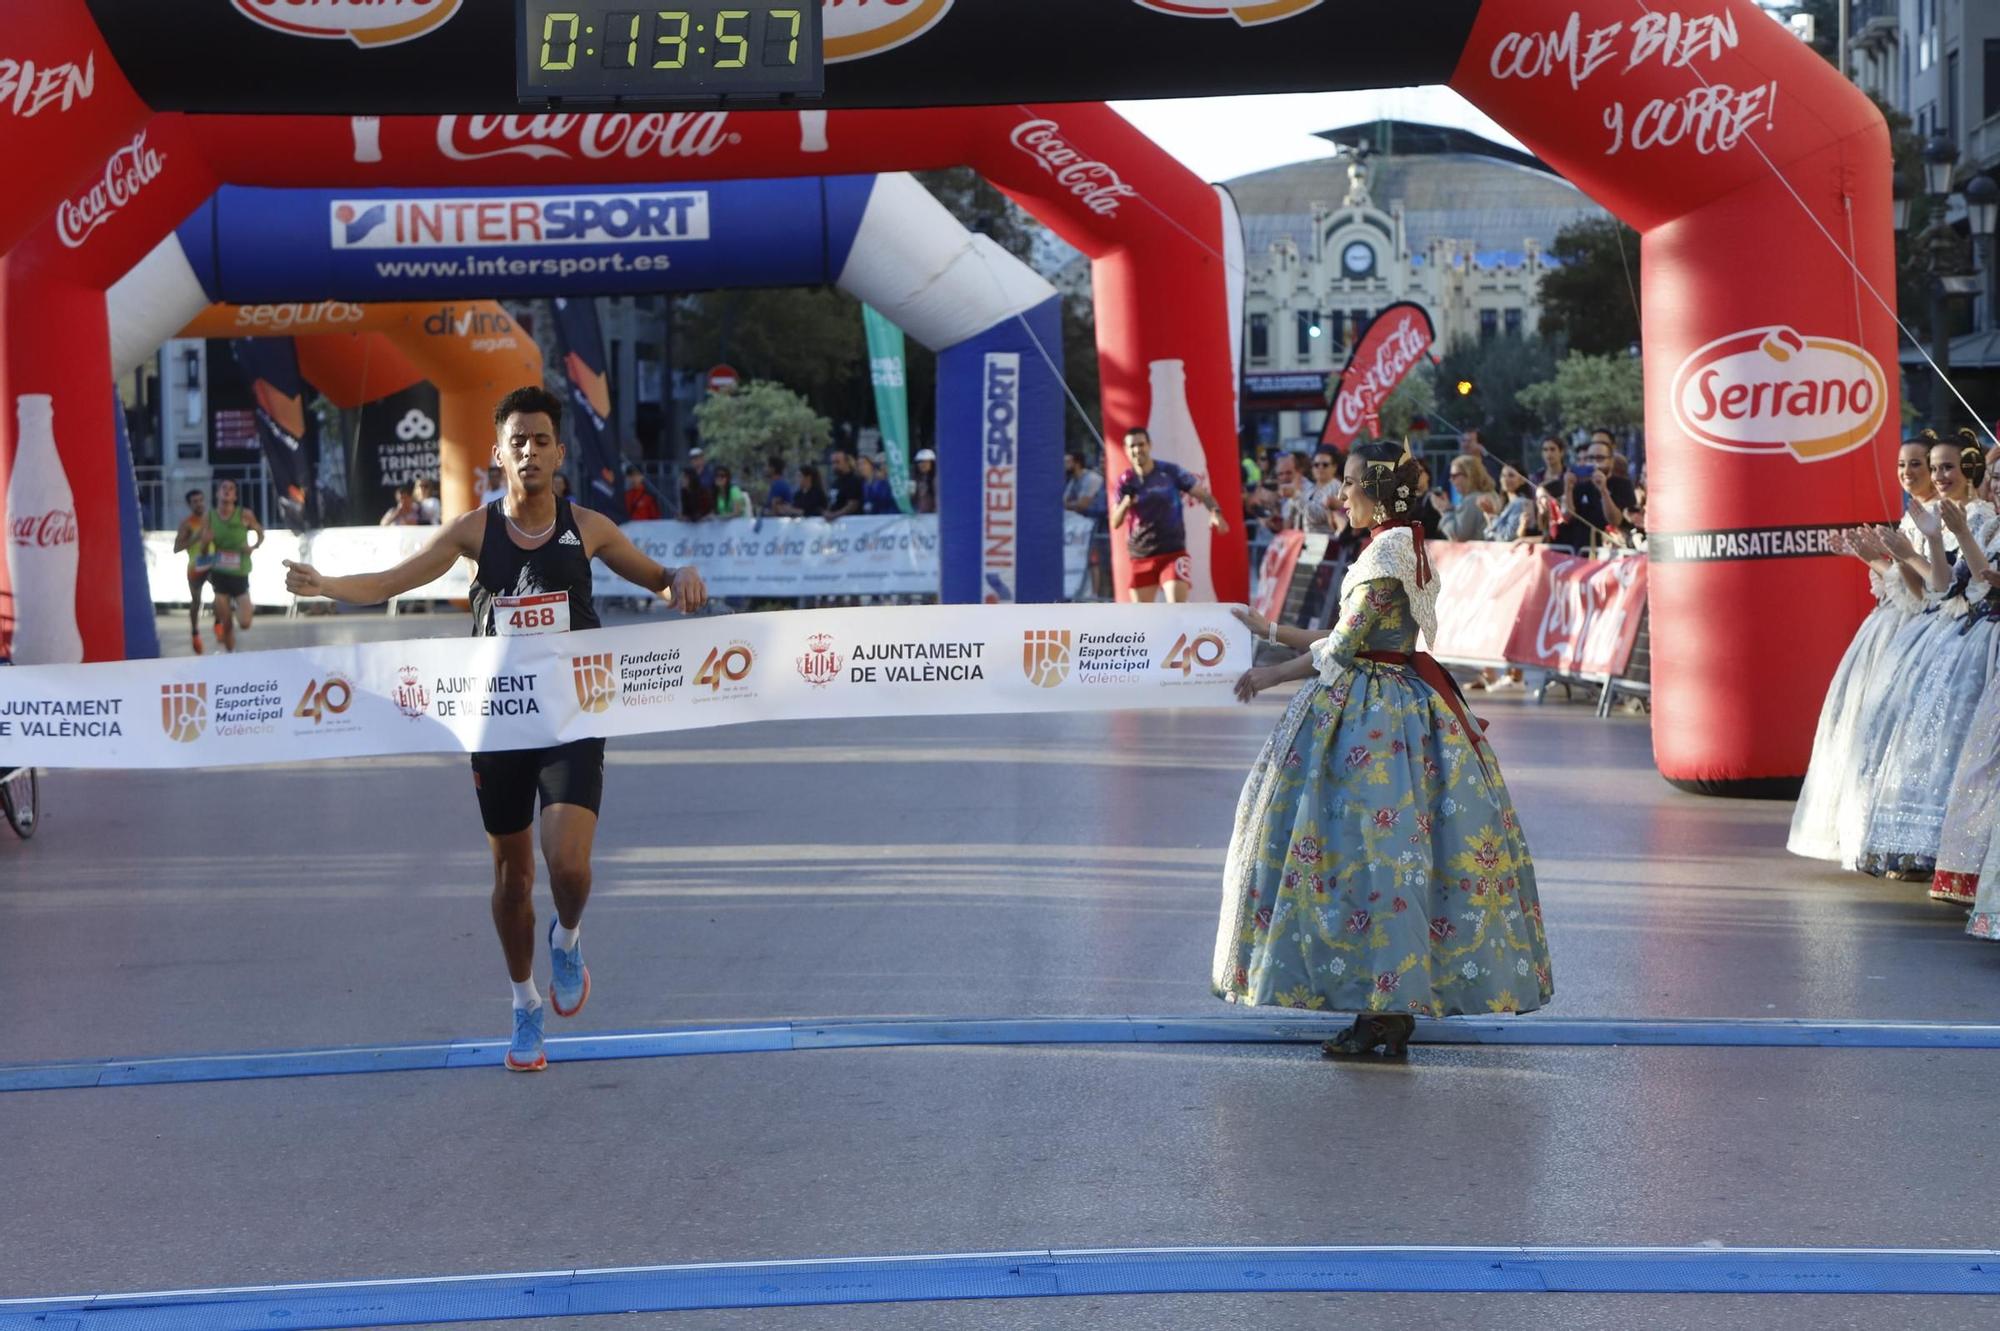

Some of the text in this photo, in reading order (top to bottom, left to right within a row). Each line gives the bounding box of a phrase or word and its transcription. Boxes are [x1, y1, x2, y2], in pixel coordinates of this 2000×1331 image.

[540, 10, 800, 70] 0:13:57
[1490, 7, 1739, 90] COME BIEN
[1632, 80, 1777, 155] CORRE!
[396, 197, 695, 244] INTERSPORT
[376, 252, 671, 278] www.intersport.es
[235, 301, 365, 329] seguros
[1692, 369, 1873, 421] Serrano
[378, 441, 440, 454] FUNDACI
[985, 362, 1017, 568] INTERSPORT
[381, 468, 441, 487] ALFON
[558, 538, 581, 546] adidas
[509, 607, 555, 628] 468
[1078, 633, 1146, 645] Fundació
[620, 649, 681, 666] Fundació
[851, 643, 985, 660] AJUNTAMENT
[1078, 646, 1148, 660] Esportiva
[1160, 633, 1225, 678] 40
[620, 663, 683, 681] Esportiva
[692, 646, 753, 692] 40
[850, 661, 984, 683] DE VALÈNCIA
[1078, 658, 1150, 672] Municipal
[436, 673, 538, 693] AJUNTMENT
[622, 675, 684, 694] Municipal
[1078, 672, 1140, 684] València
[215, 680, 279, 696] Fundació
[0, 699, 123, 716] JUNTAMENT
[215, 695, 281, 712] Esportiva
[294, 678, 352, 725] 40
[437, 700, 457, 717] DE
[622, 692, 675, 707] València
[215, 709, 284, 725] Municipal
[20, 718, 123, 737] VALÈNCIA
